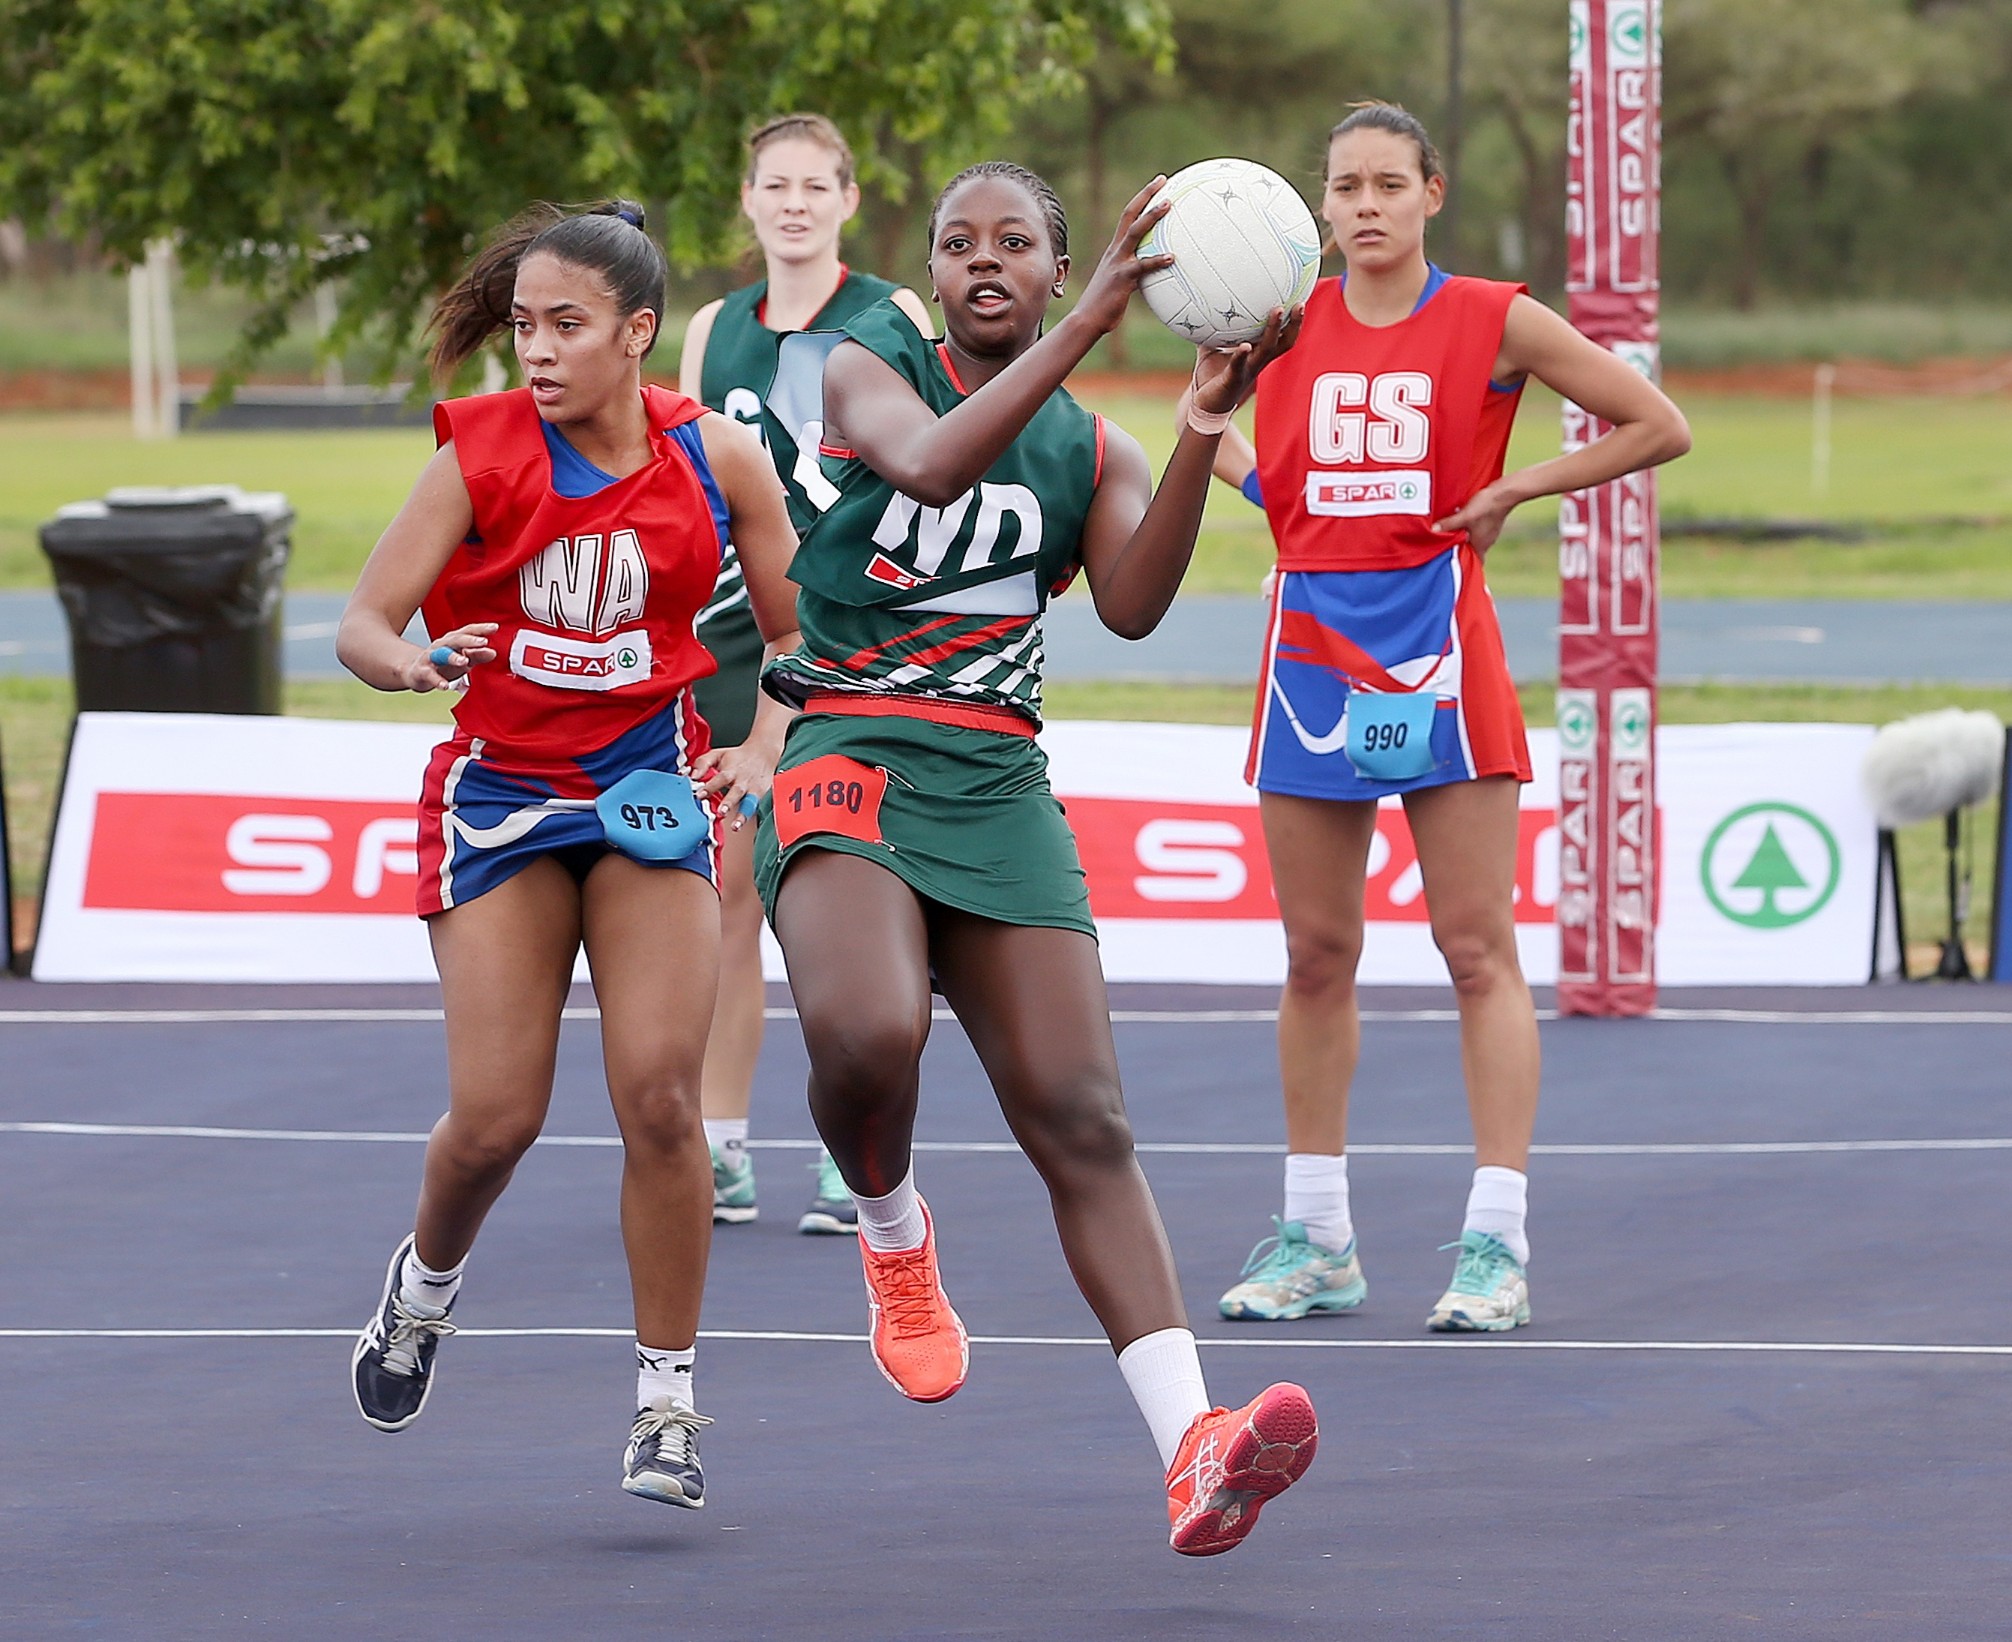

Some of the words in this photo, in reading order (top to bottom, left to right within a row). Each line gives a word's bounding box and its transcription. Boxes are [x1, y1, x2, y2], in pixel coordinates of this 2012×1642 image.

[1618, 71, 1647, 237] SPAR
[1309, 372, 1432, 464] GS
[1332, 484, 1396, 502] SPAR
[519, 529, 649, 637] WA
[542, 652, 615, 676] SPAR
[1364, 722, 1408, 752] 990
[620, 803, 679, 831] 973
[789, 781, 863, 814] 1180
[1561, 763, 1588, 927] SPAR
[1617, 763, 1643, 928] SPAR
